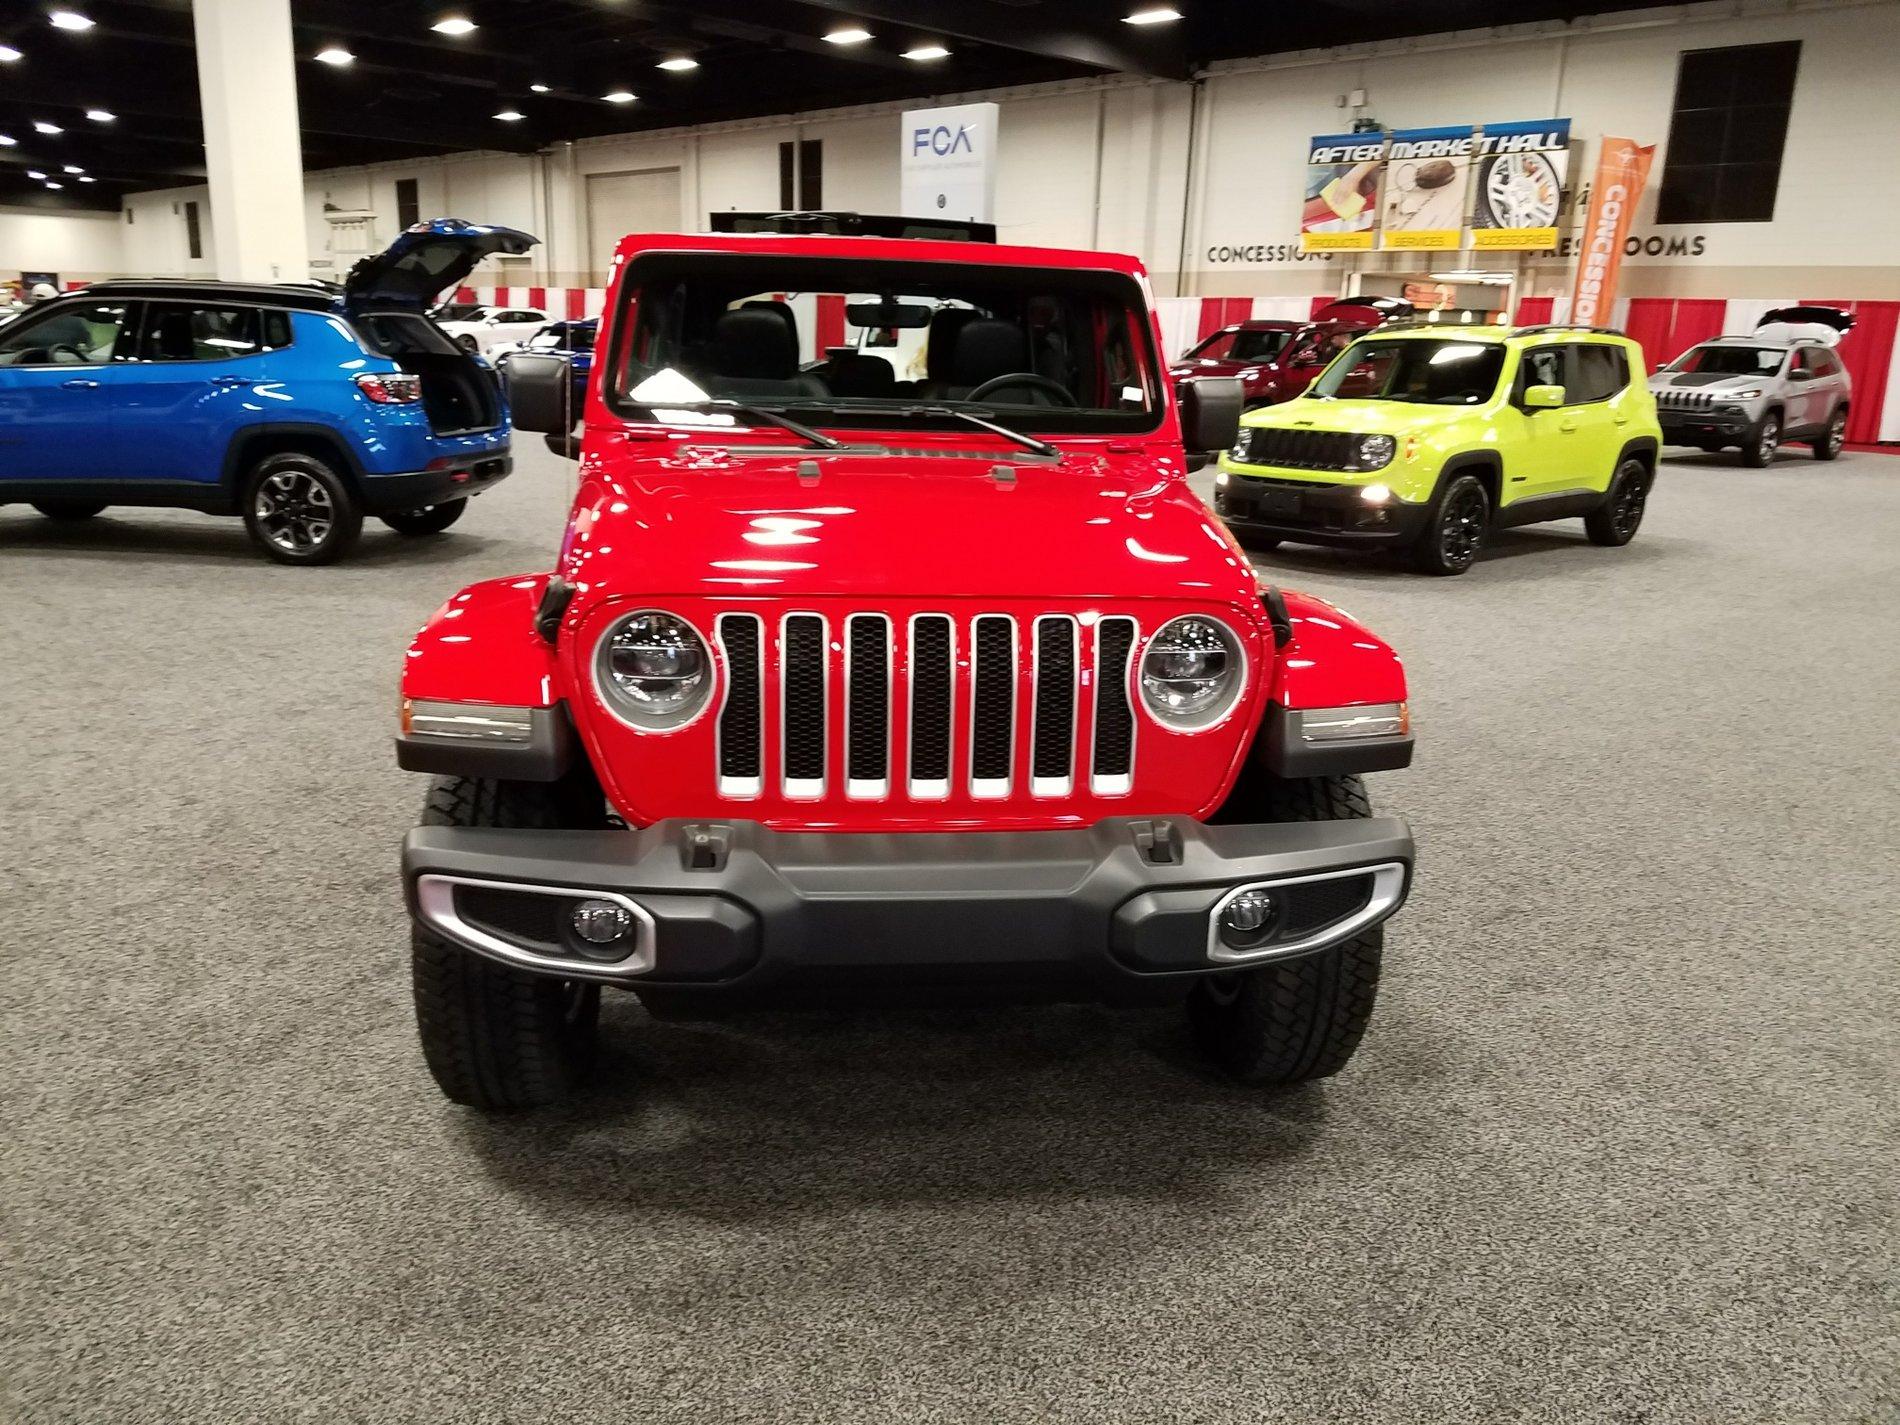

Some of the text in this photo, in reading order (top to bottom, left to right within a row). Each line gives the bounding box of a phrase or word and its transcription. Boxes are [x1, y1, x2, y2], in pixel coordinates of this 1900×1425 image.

[913, 125, 972, 157] FCA
[1309, 143, 1385, 163] AFTER
[1496, 132, 1564, 154] HALL
[1394, 236, 1445, 247] SERVICES
[1474, 234, 1552, 246] ACCESSORIES
